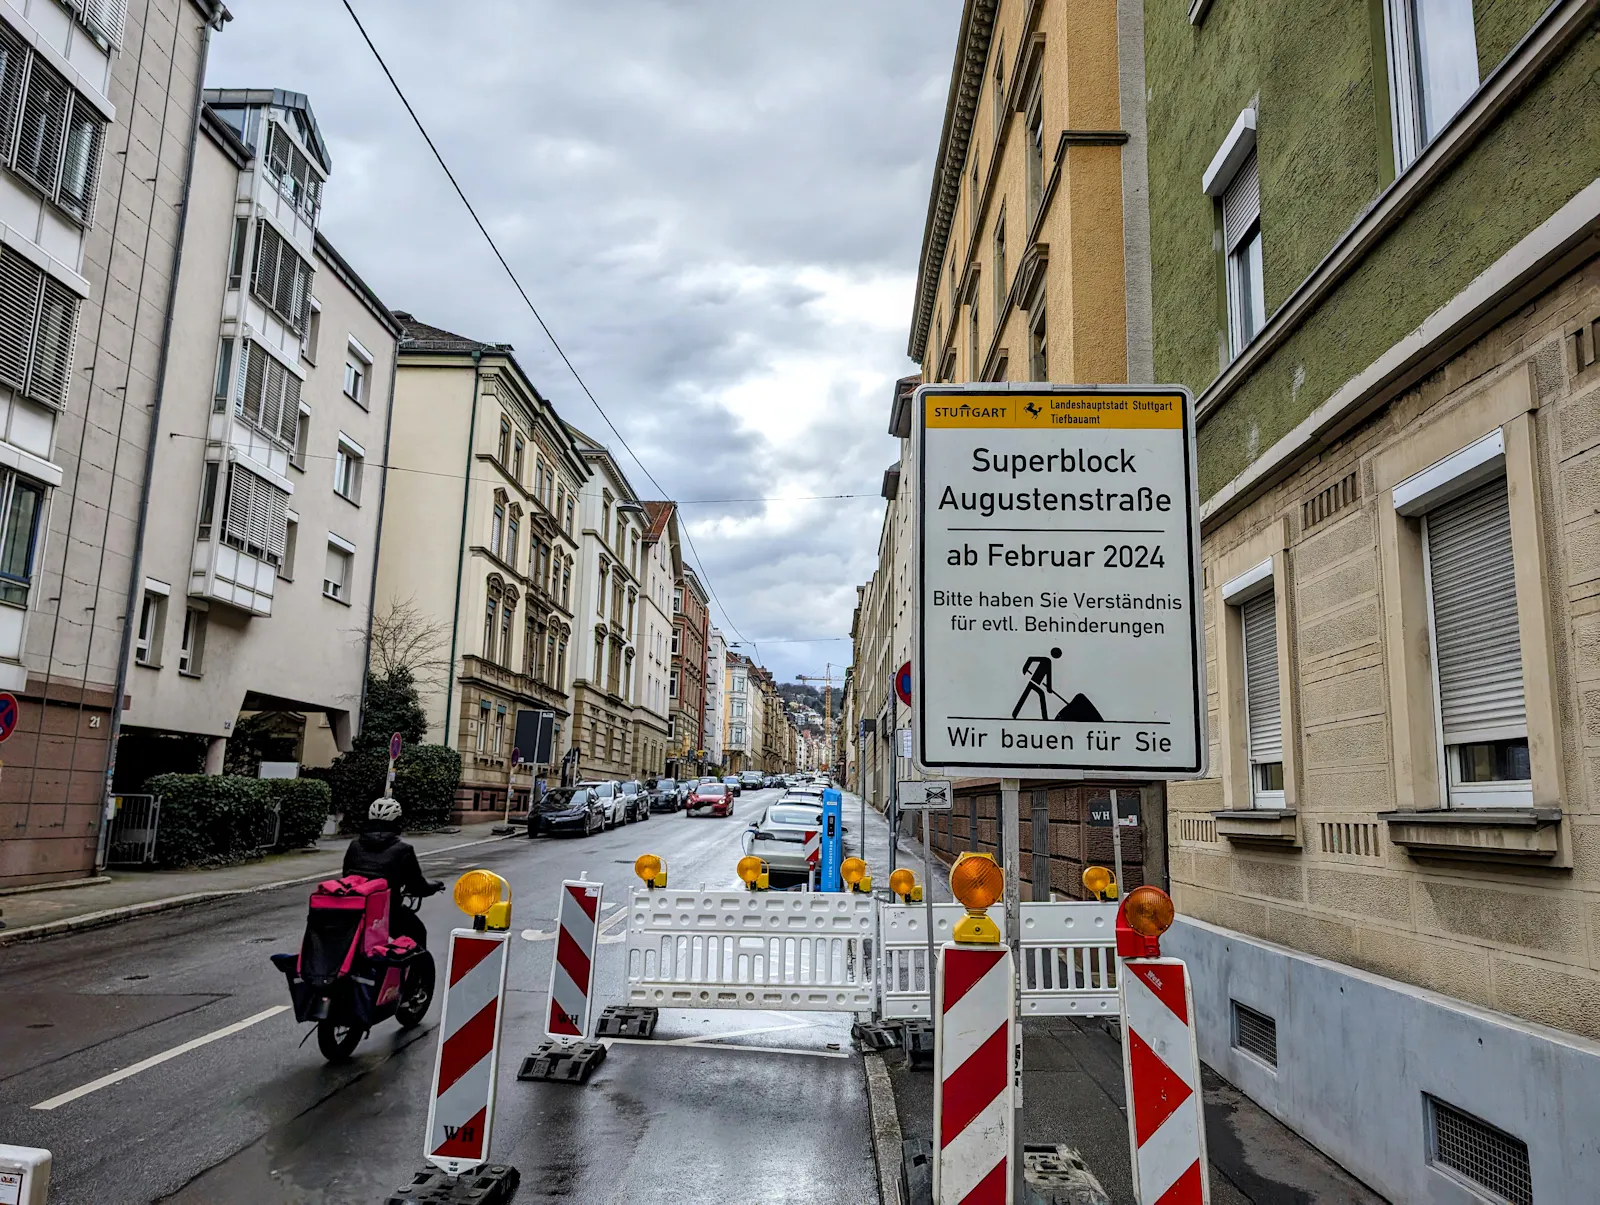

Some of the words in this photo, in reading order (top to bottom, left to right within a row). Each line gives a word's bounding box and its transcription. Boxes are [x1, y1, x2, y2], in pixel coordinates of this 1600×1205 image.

[934, 403, 1007, 418] STUTTGART
[1050, 400, 1128, 411] Landeshauptstadt
[1132, 401, 1173, 411] Stuttgart
[1051, 414, 1100, 424] Tiefbauamt
[972, 448, 1137, 479] Superblock
[938, 486, 1171, 517] Augustenstraße
[947, 544, 978, 566] ab
[988, 544, 1095, 567] Februar
[1103, 545, 1165, 568] 2024
[933, 591, 973, 607] Bitte
[979, 591, 1034, 608] haben
[1040, 592, 1068, 609] Sie
[1073, 593, 1182, 610] Verständnis
[951, 615, 977, 631] für
[982, 616, 1018, 631] evtl.
[1025, 616, 1165, 638] Behinderungen
[89, 716, 101, 728] 21
[947, 727, 989, 748] Wir
[1001, 728, 1074, 751] bauen
[1086, 730, 1121, 752] für
[1135, 731, 1172, 753] Sie
[1091, 811, 1110, 820] WH
[557, 1013, 579, 1025] WH
[443, 1125, 475, 1142] WH
